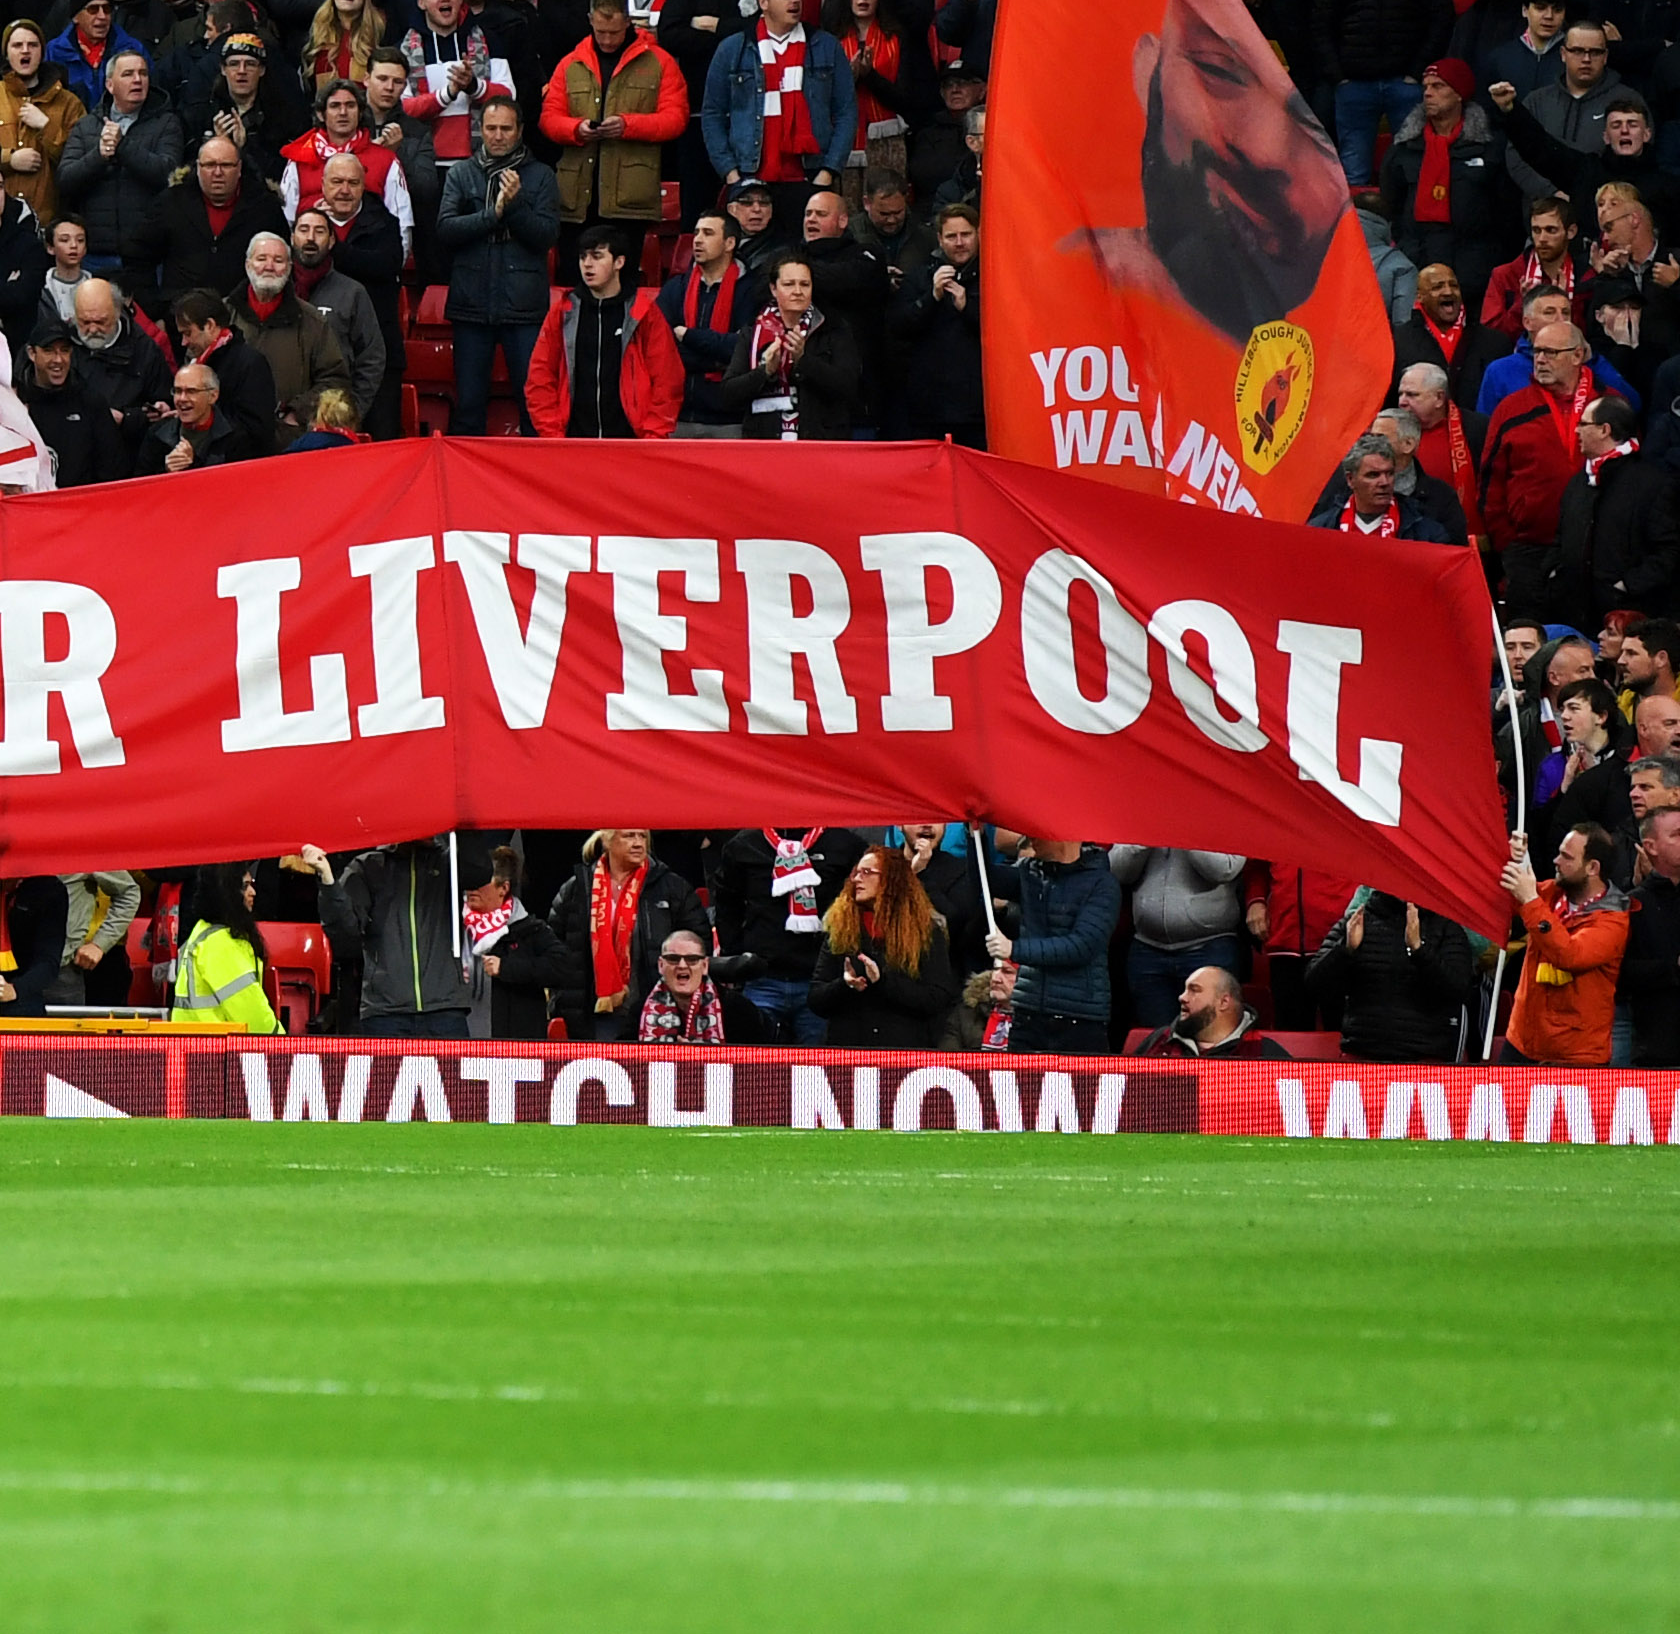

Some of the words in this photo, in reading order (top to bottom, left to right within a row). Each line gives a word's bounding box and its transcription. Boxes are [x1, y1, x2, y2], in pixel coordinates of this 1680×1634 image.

[1030, 345, 1139, 408] YOU
[1050, 409, 1164, 470] WA
[1240, 418, 1258, 438] FOR
[217, 531, 1402, 826] LIVERPOOL
[241, 1052, 734, 1128] WATCH
[791, 1064, 1127, 1136] NOW
